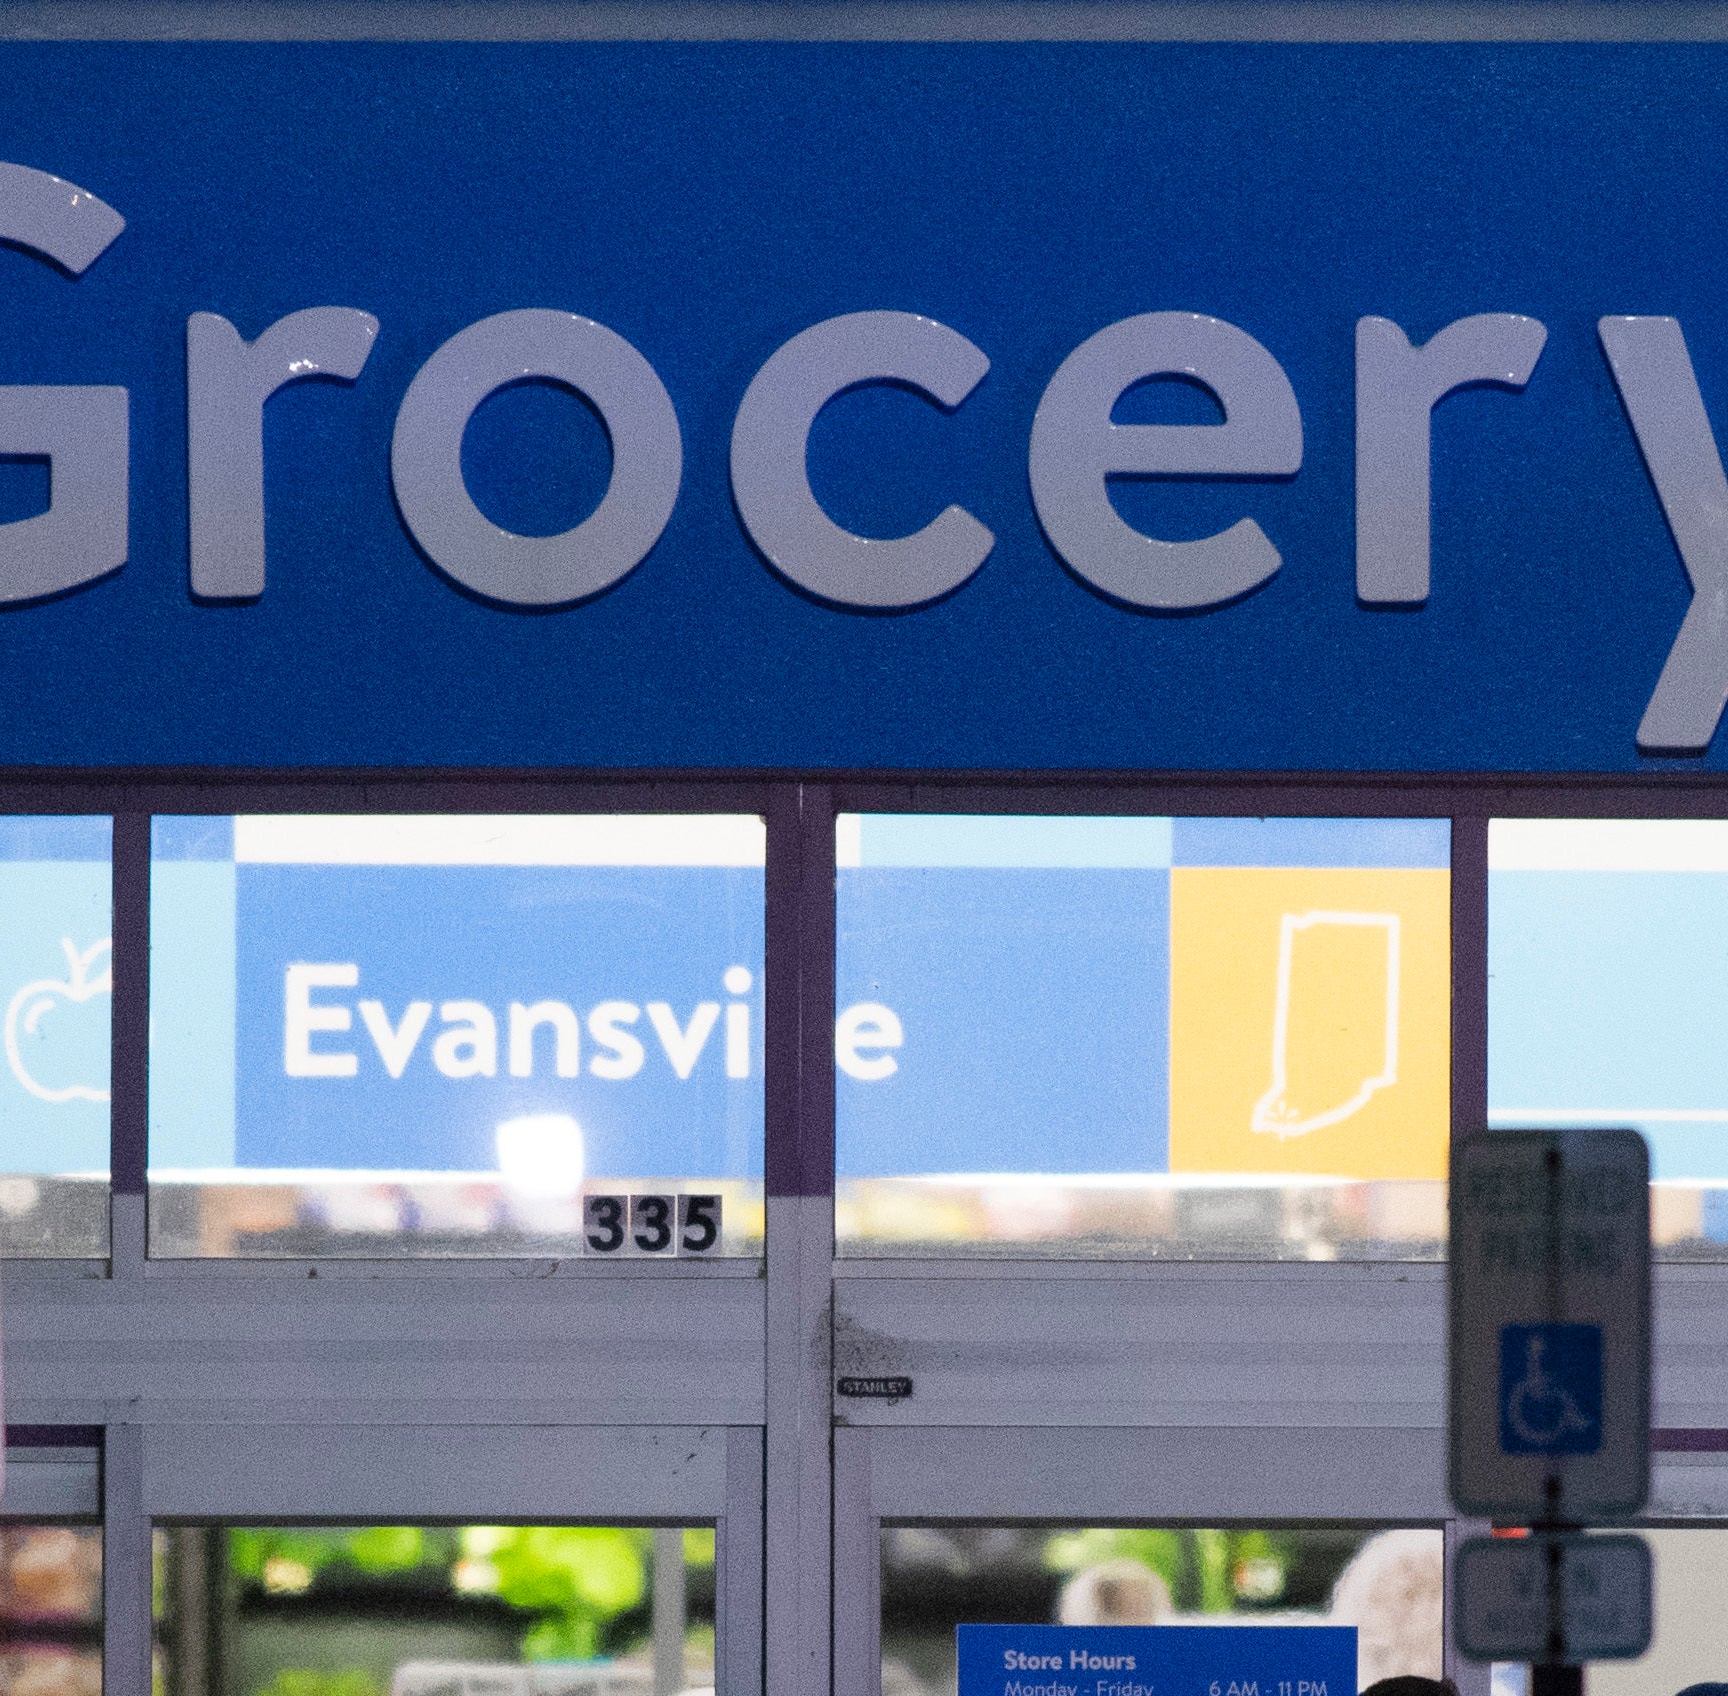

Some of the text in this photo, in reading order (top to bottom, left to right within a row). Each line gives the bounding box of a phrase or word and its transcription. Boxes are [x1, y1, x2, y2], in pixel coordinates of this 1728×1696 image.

[284, 962, 904, 1080] Evansvie
[585, 1196, 719, 1252] 335
[1003, 1650, 1137, 1671] Store Hours
